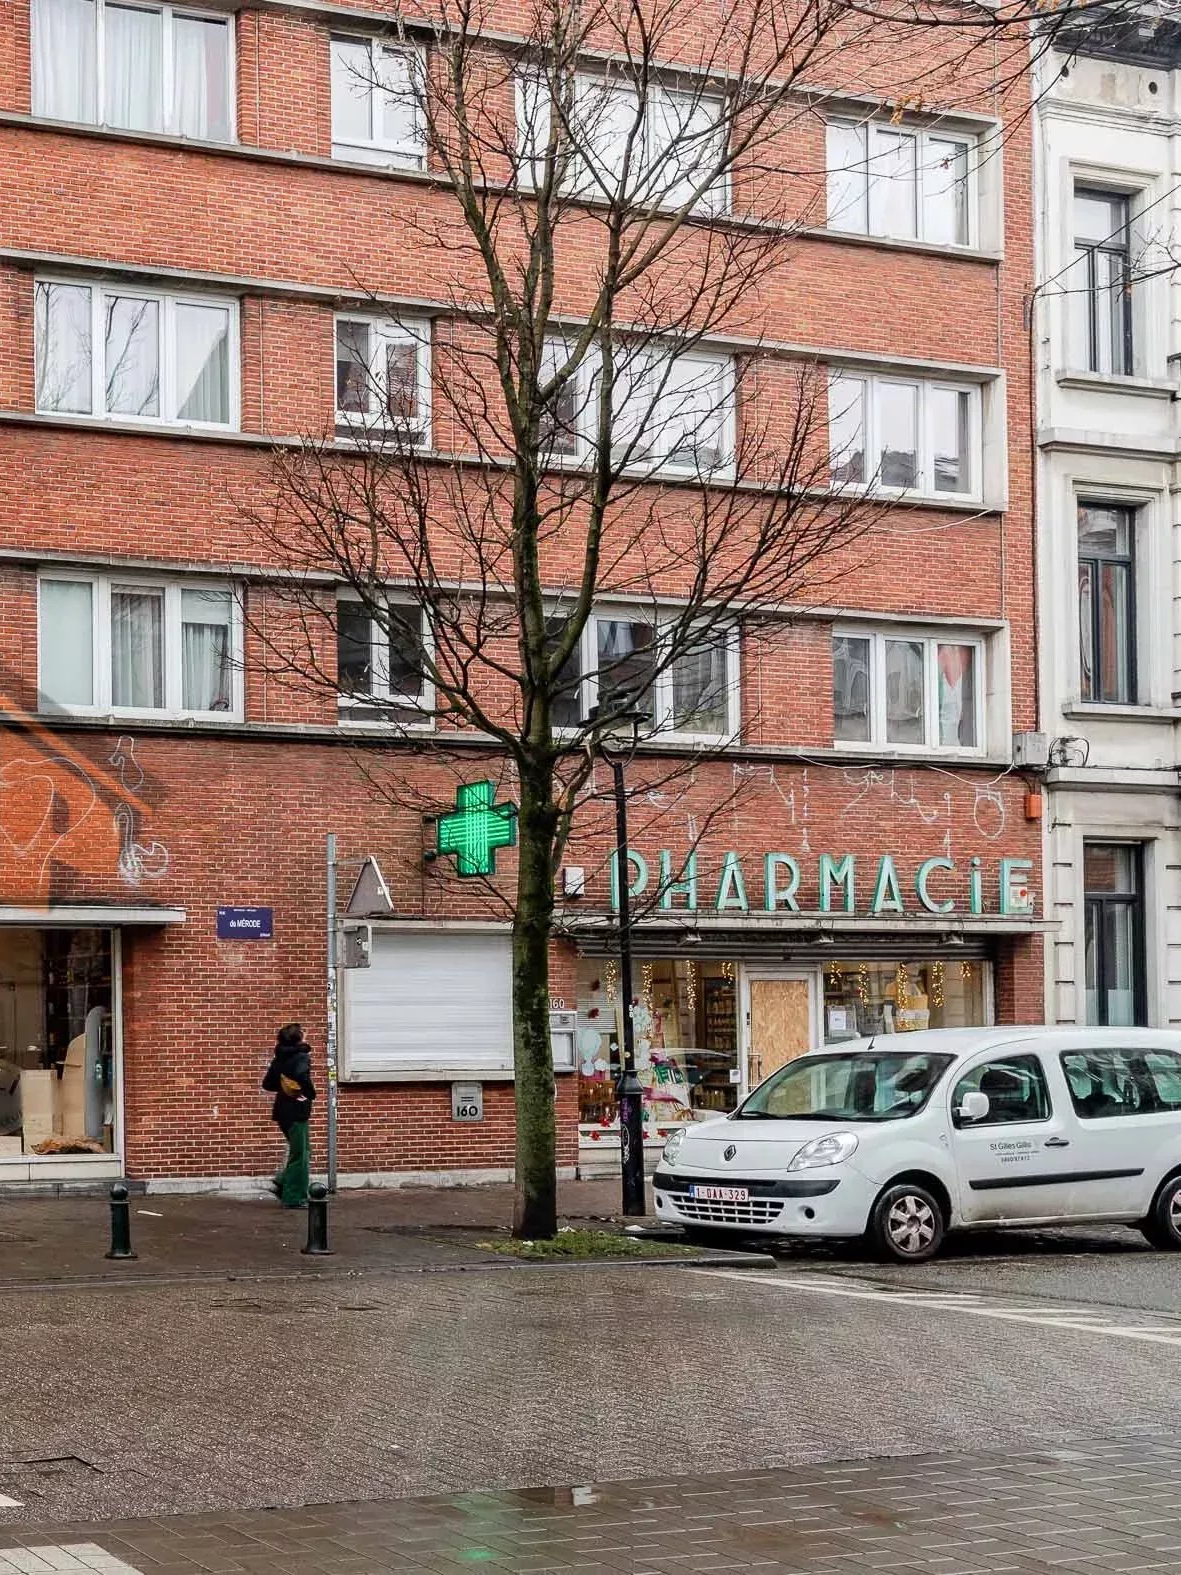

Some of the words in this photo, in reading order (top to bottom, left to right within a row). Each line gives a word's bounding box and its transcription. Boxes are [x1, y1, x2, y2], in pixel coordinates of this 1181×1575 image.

[237, 917, 262, 928] MÉRODE
[549, 998, 565, 1009] 160
[457, 1105, 478, 1117] 160
